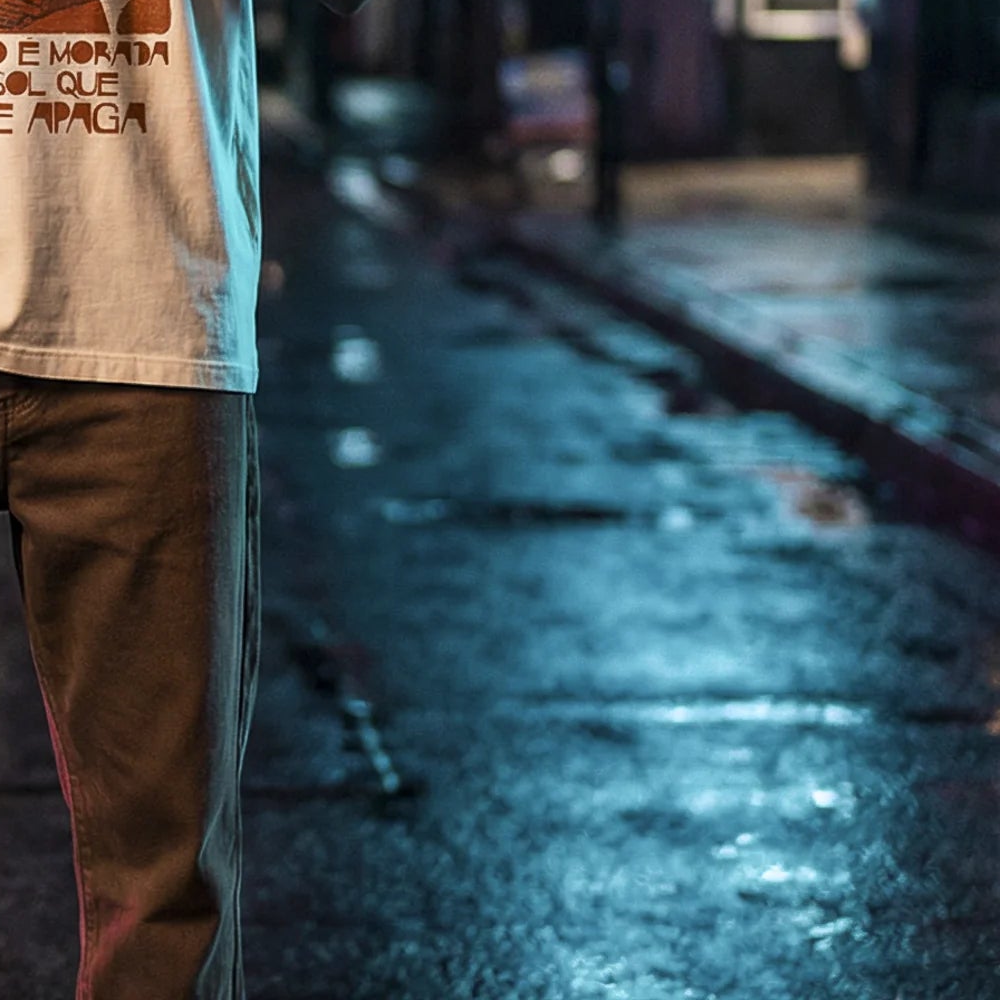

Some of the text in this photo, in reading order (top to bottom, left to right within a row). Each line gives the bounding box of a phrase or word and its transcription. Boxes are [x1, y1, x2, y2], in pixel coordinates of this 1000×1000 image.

[18, 36, 40, 66] É
[50, 40, 169, 66] MORADA
[56, 70, 119, 99] QUE
[27, 101, 147, 134] APAGA
